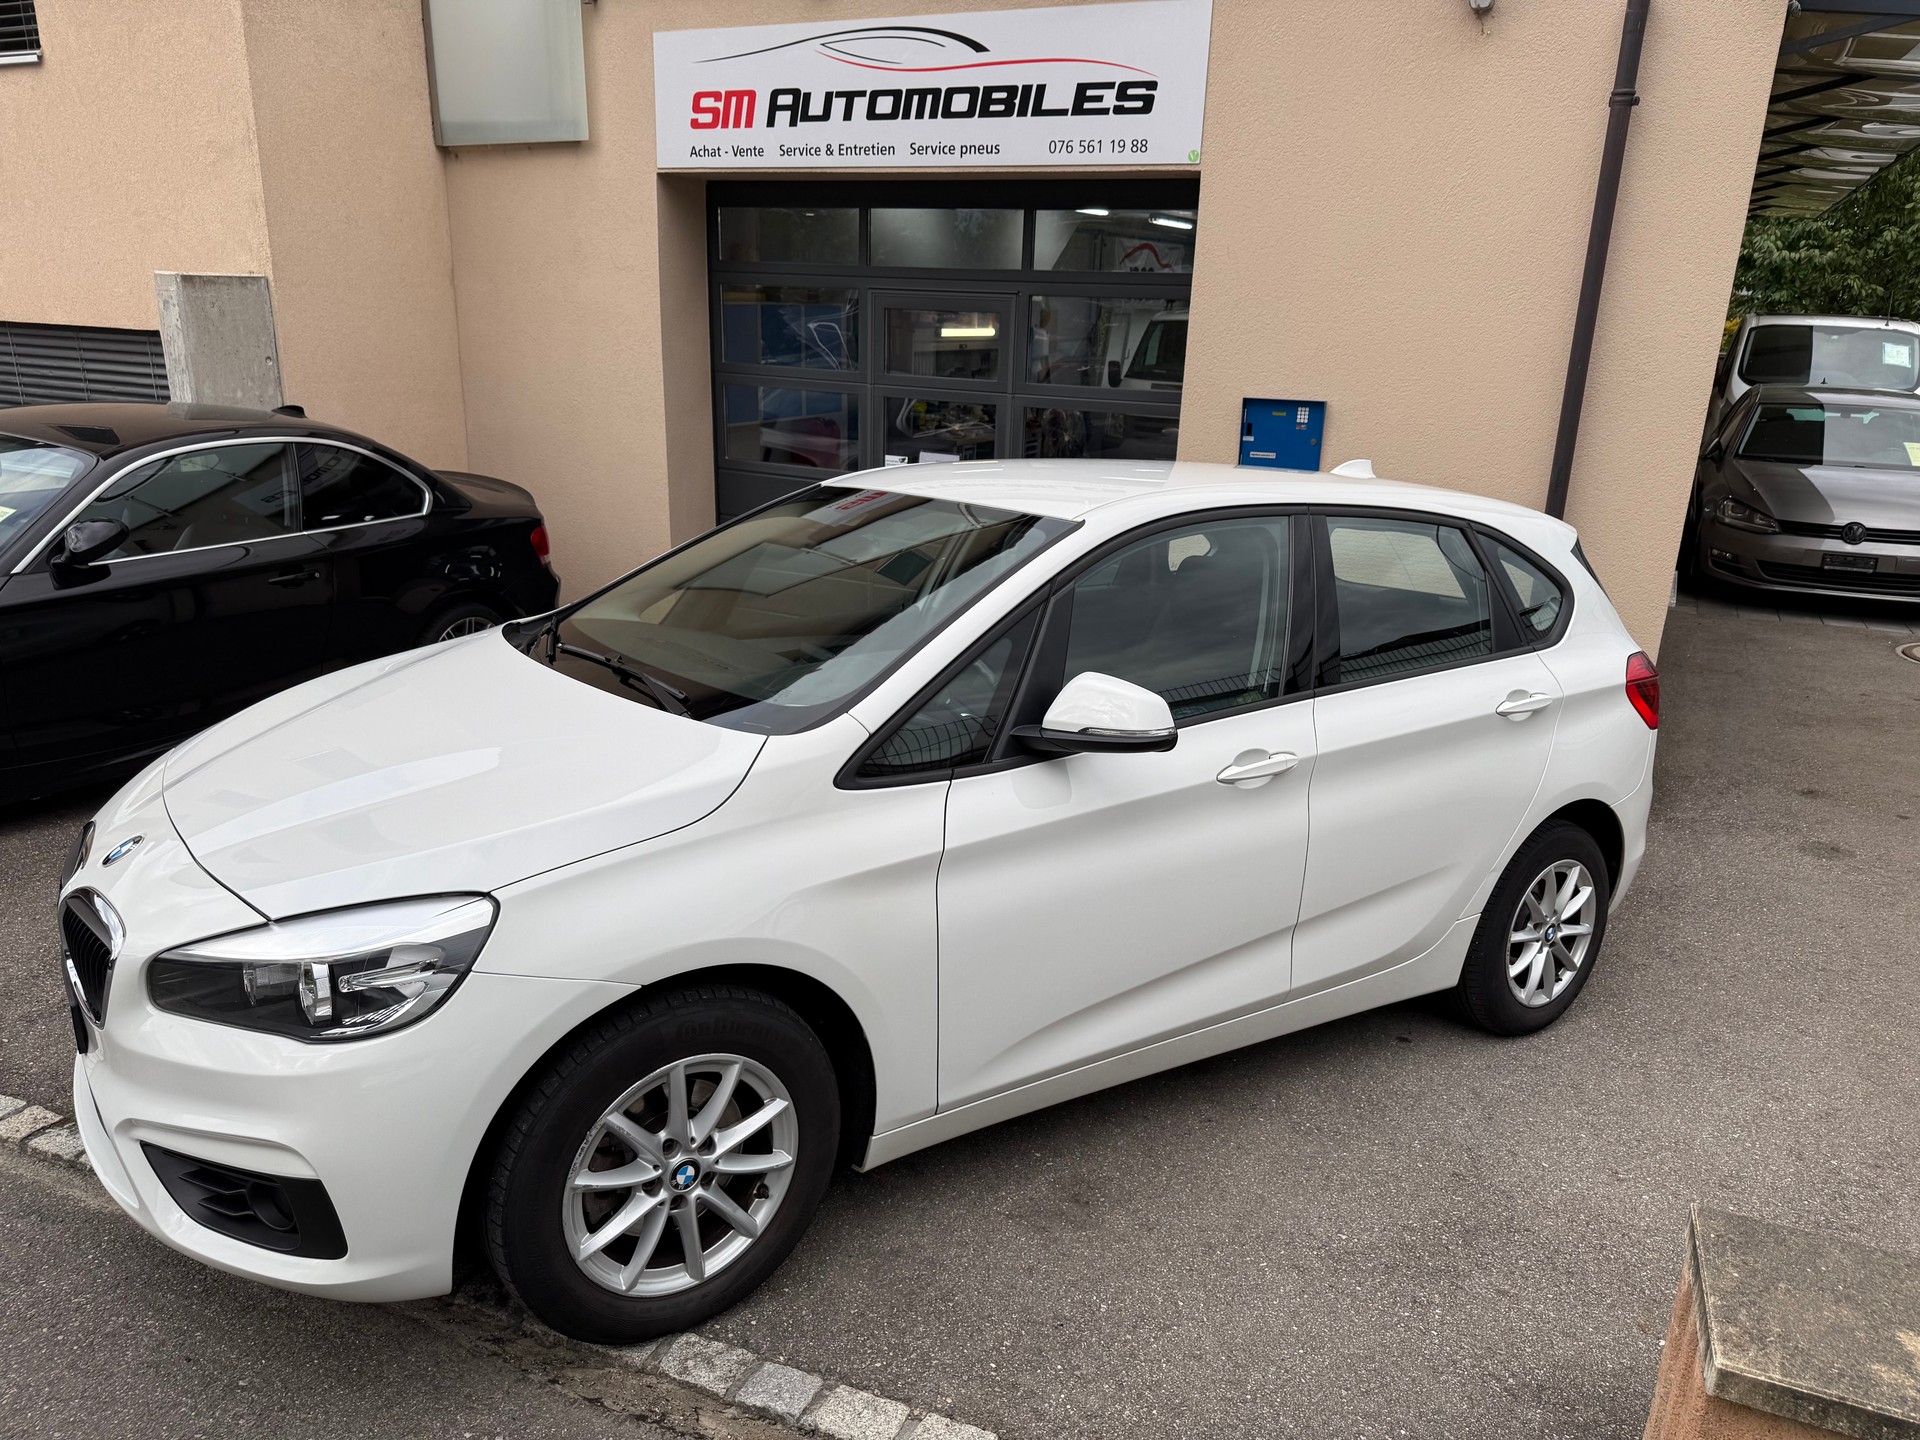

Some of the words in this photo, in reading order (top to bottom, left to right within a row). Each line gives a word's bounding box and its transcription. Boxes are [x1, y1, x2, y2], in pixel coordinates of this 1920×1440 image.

[690, 90, 756, 129] SM
[766, 80, 1158, 128] AUTOMOBILES
[690, 145, 722, 158] Achat
[732, 145, 764, 158] Vente
[780, 145, 822, 157] Service
[826, 144, 834, 156] &
[839, 144, 895, 156] Entretien
[910, 143, 956, 156] Service
[960, 145, 1000, 158] pneus
[1049, 140, 1073, 154] 076
[1079, 139, 1102, 154] 561
[1110, 139, 1126, 153] 19
[1131, 139, 1149, 153] 88
